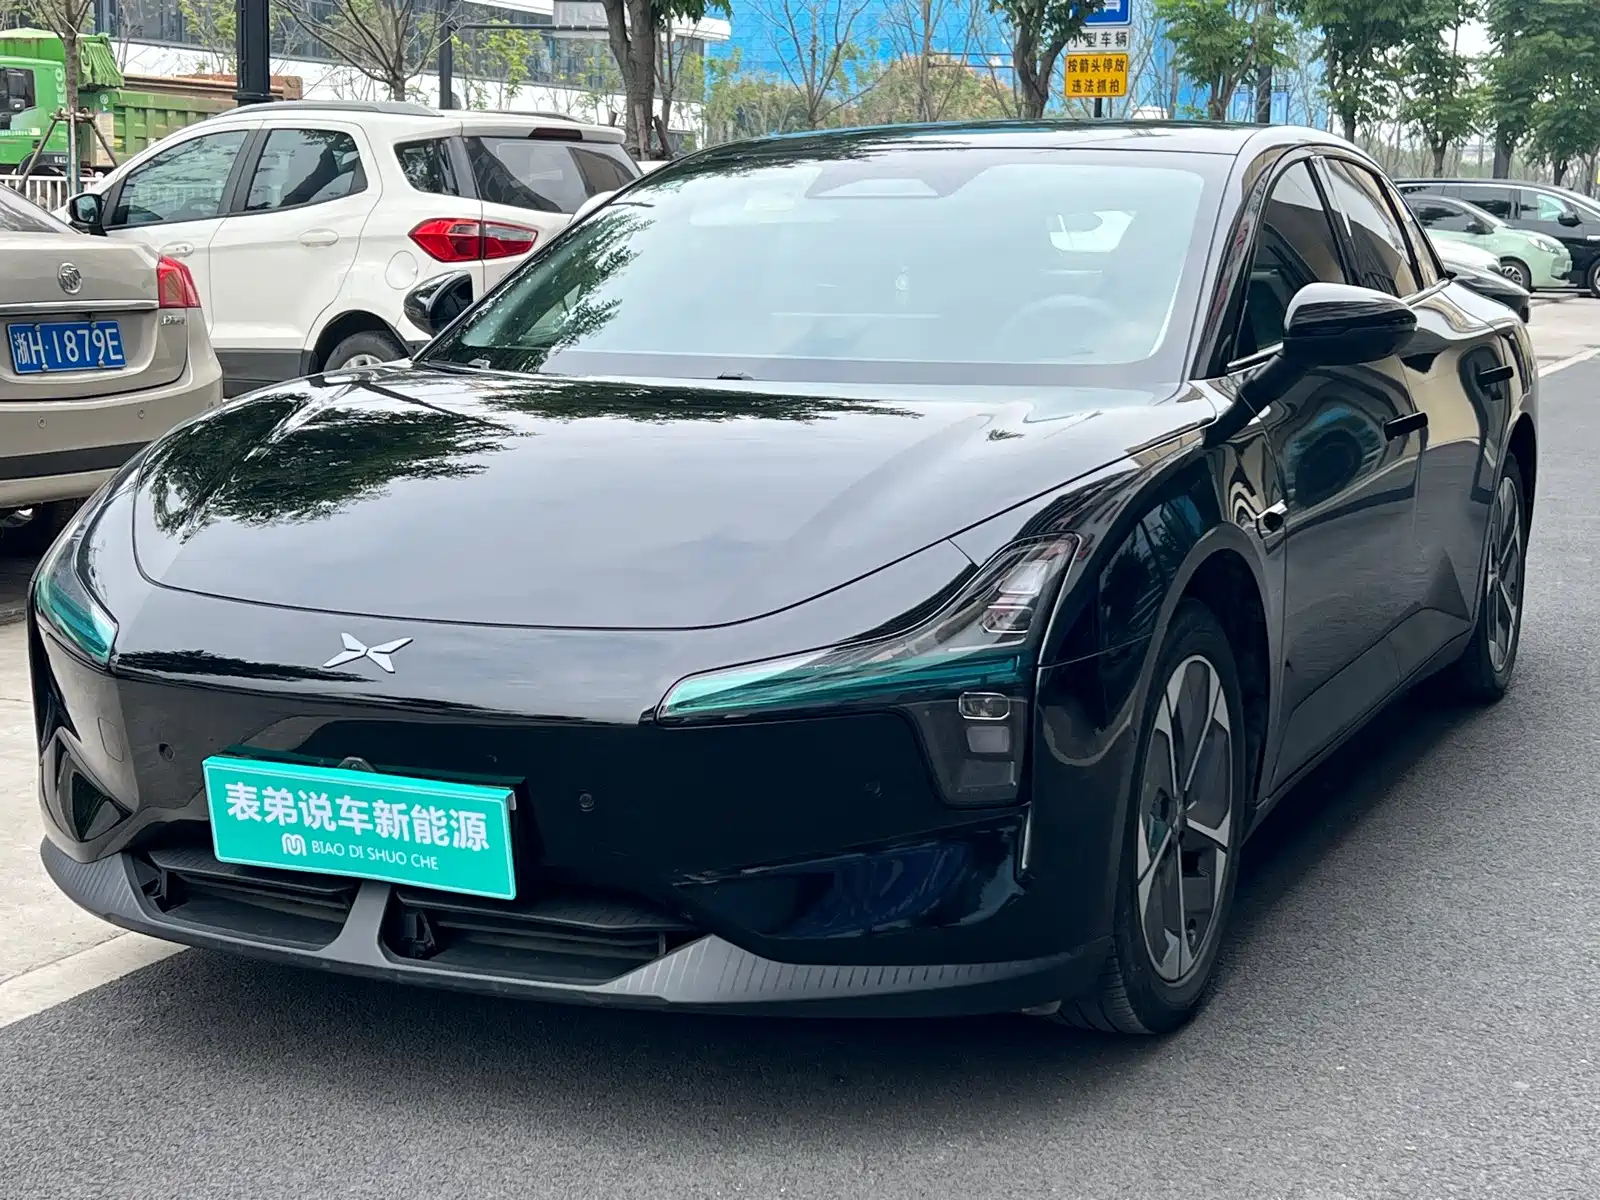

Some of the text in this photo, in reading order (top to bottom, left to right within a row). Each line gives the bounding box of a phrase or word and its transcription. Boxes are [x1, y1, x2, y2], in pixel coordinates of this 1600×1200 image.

[1068, 58, 1125, 73] 按箭头停放
[1072, 78, 1119, 93] 违法抓拍
[225, 782, 490, 852] 表弟说车新能源
[311, 841, 439, 870] BIAO DI SHUO CHE
